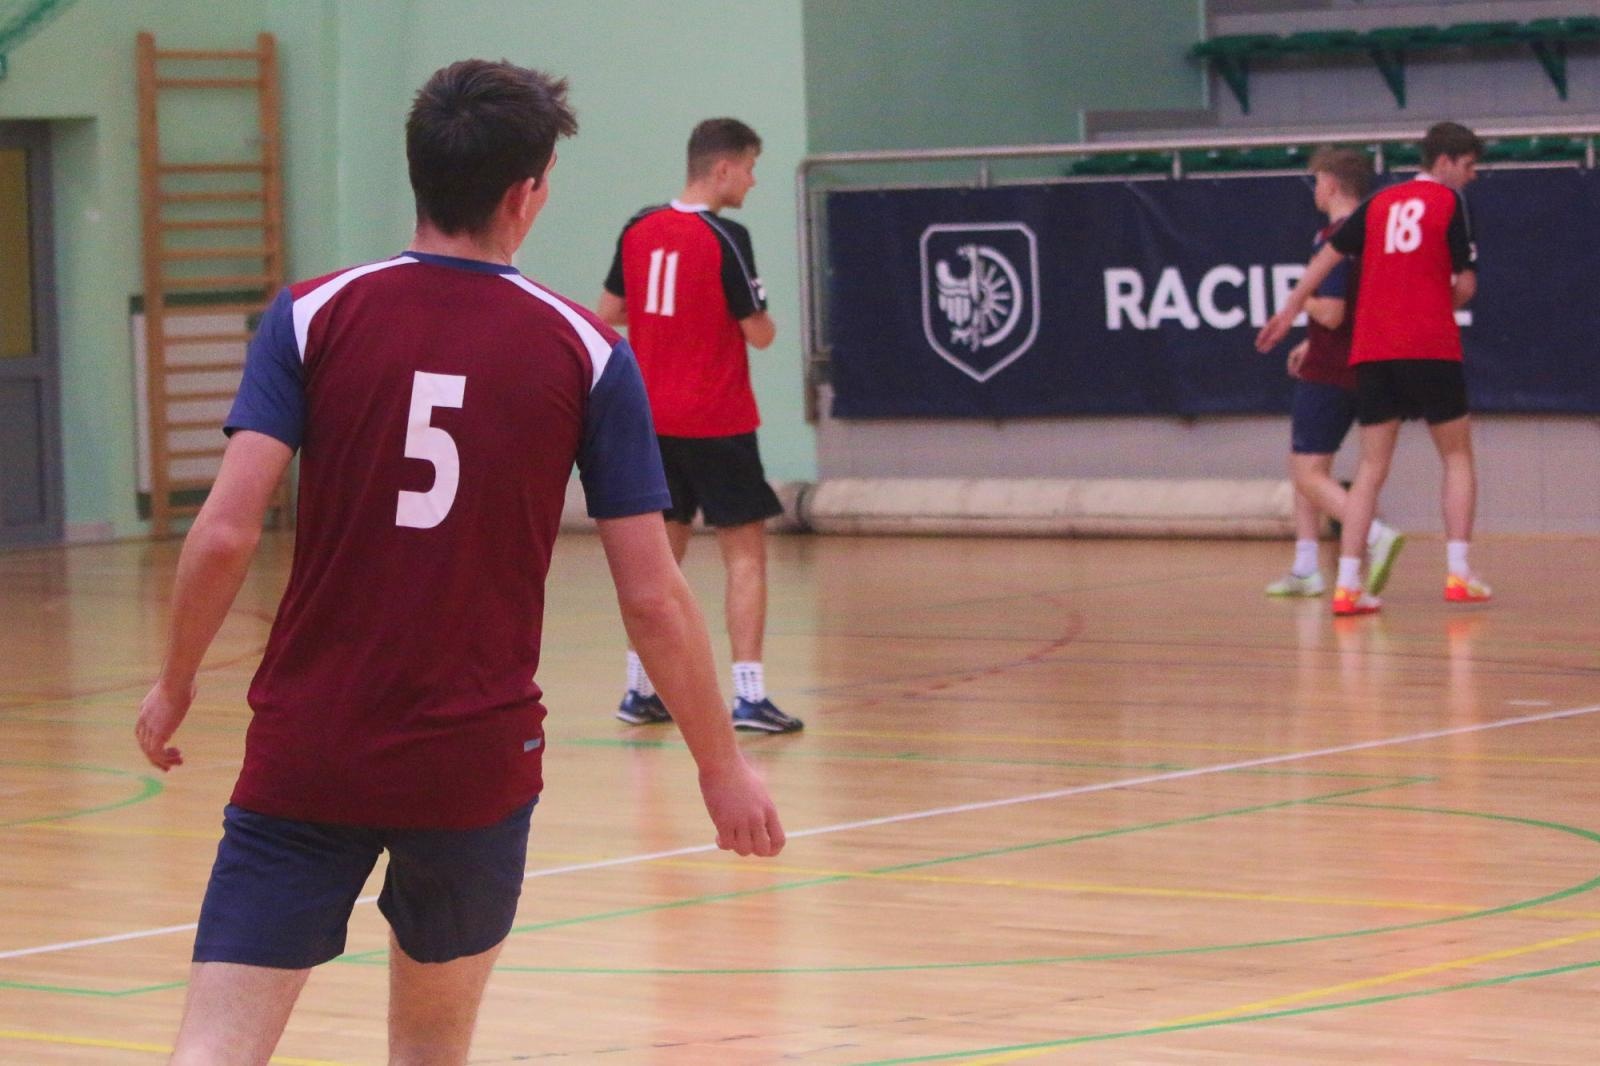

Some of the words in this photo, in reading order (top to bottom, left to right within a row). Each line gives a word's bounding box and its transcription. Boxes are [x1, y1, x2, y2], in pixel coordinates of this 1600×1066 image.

[1384, 198, 1425, 254] 18
[644, 248, 678, 317] 11
[395, 370, 466, 529] 5
